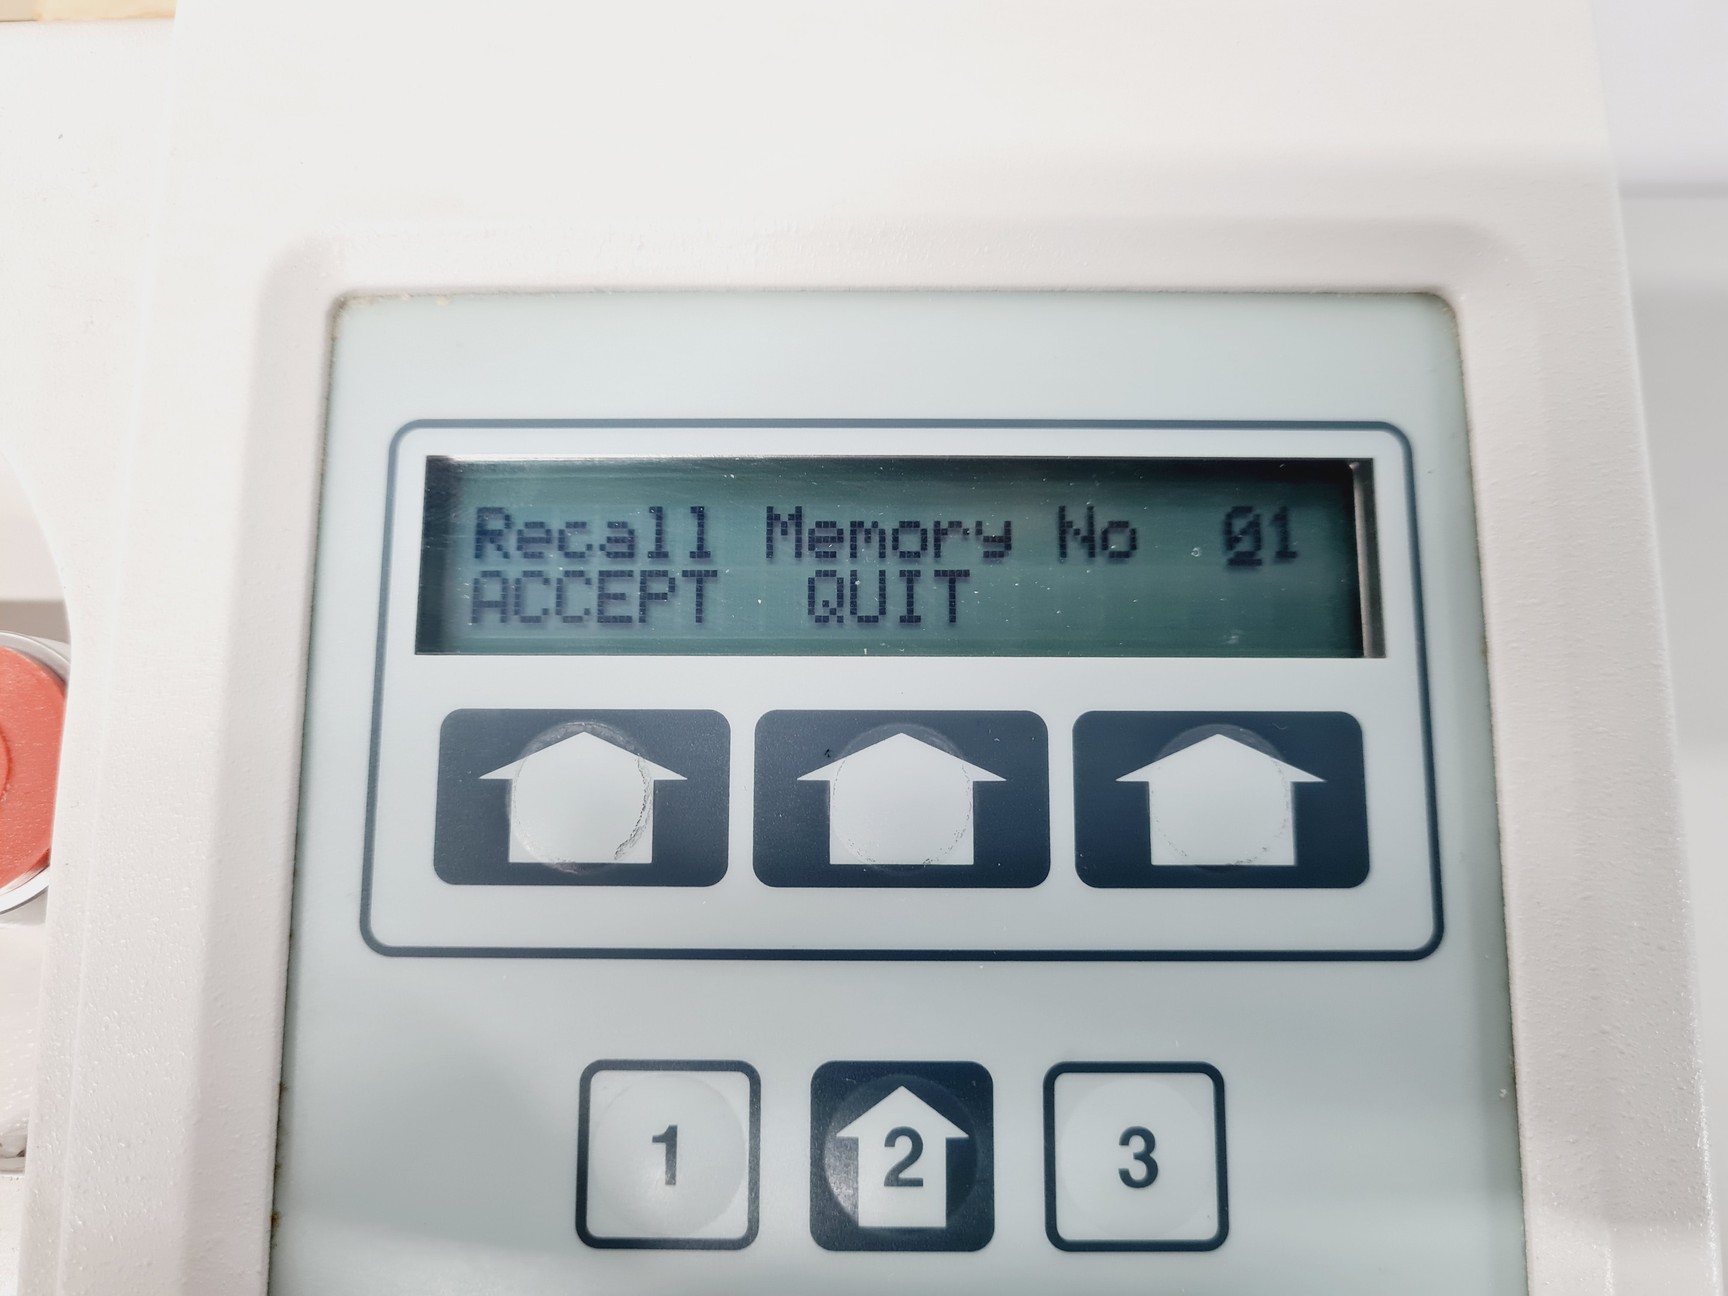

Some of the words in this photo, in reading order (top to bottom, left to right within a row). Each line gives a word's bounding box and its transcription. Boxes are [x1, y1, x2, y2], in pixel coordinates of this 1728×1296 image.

[475, 506, 711, 559] Recall
[766, 506, 1012, 559] Memory
[1058, 505, 1137, 559] No
[1225, 505, 1298, 564] 01
[471, 569, 718, 624] ACCEPT
[808, 569, 970, 624] QUIT
[651, 1124, 678, 1186] 1
[883, 1125, 924, 1188] 2
[1118, 1125, 1159, 1189] 3
